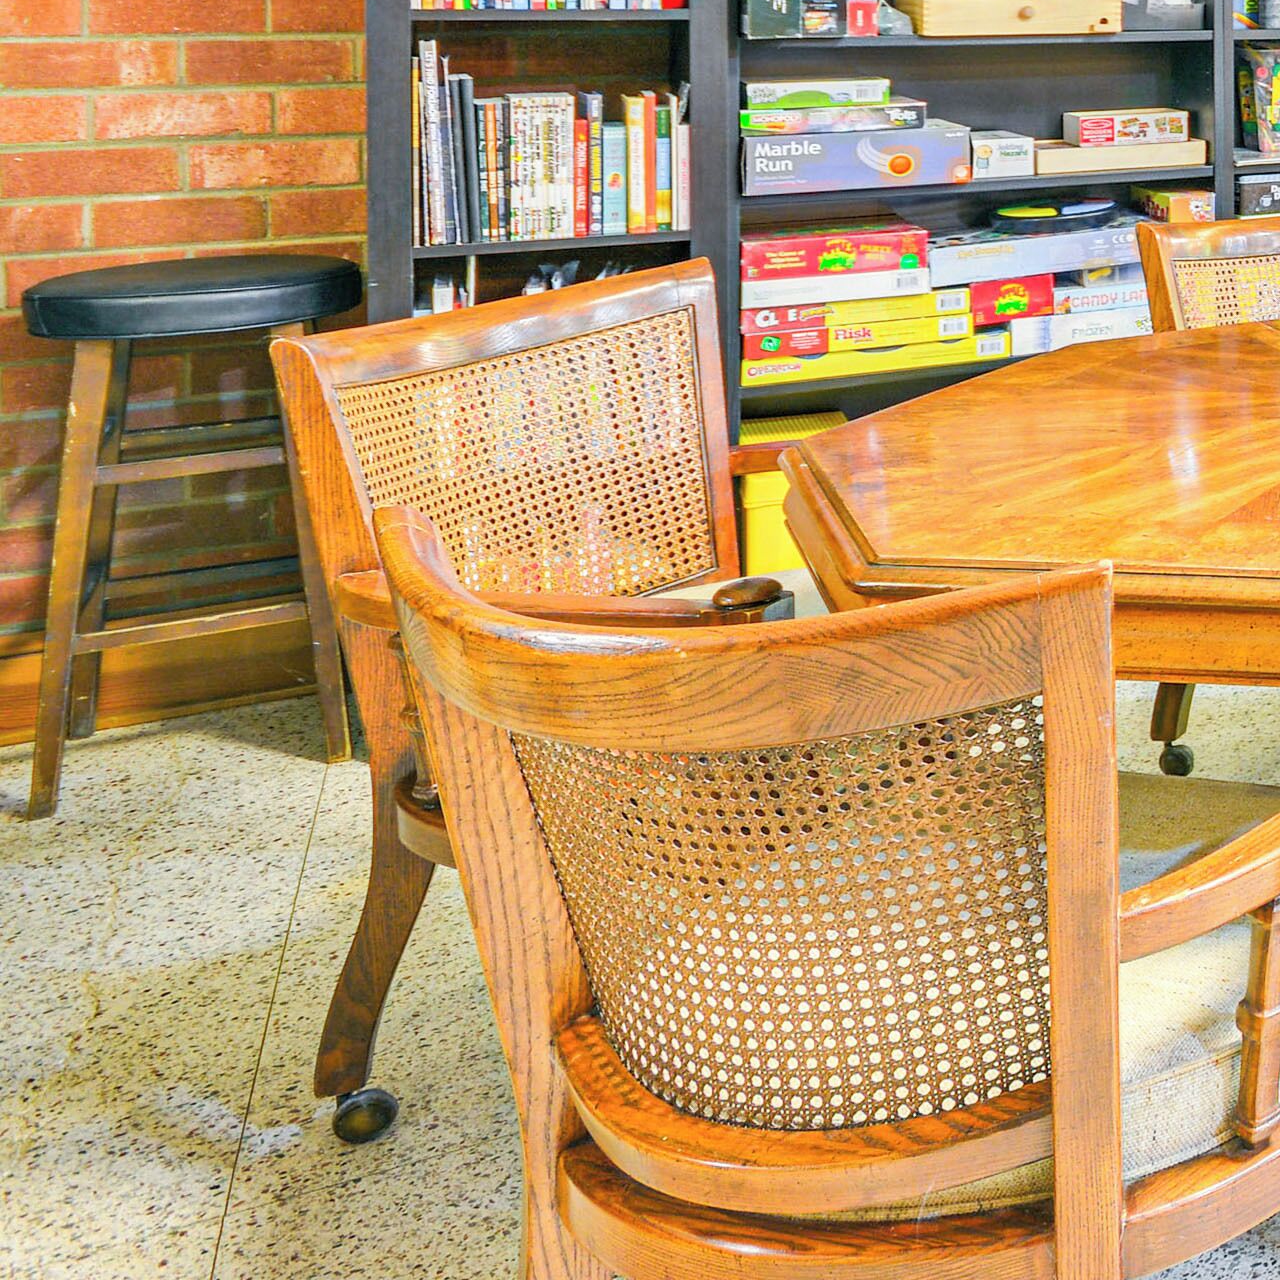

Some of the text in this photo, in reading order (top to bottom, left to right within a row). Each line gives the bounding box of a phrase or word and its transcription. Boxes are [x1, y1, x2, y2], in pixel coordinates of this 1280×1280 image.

[577, 141, 586, 168] JONAH
[754, 140, 822, 158] Marble
[755, 157, 793, 173] Run
[577, 185, 586, 210] WHALE
[1071, 292, 1118, 309] CANDY
[833, 327, 872, 340] Risk
